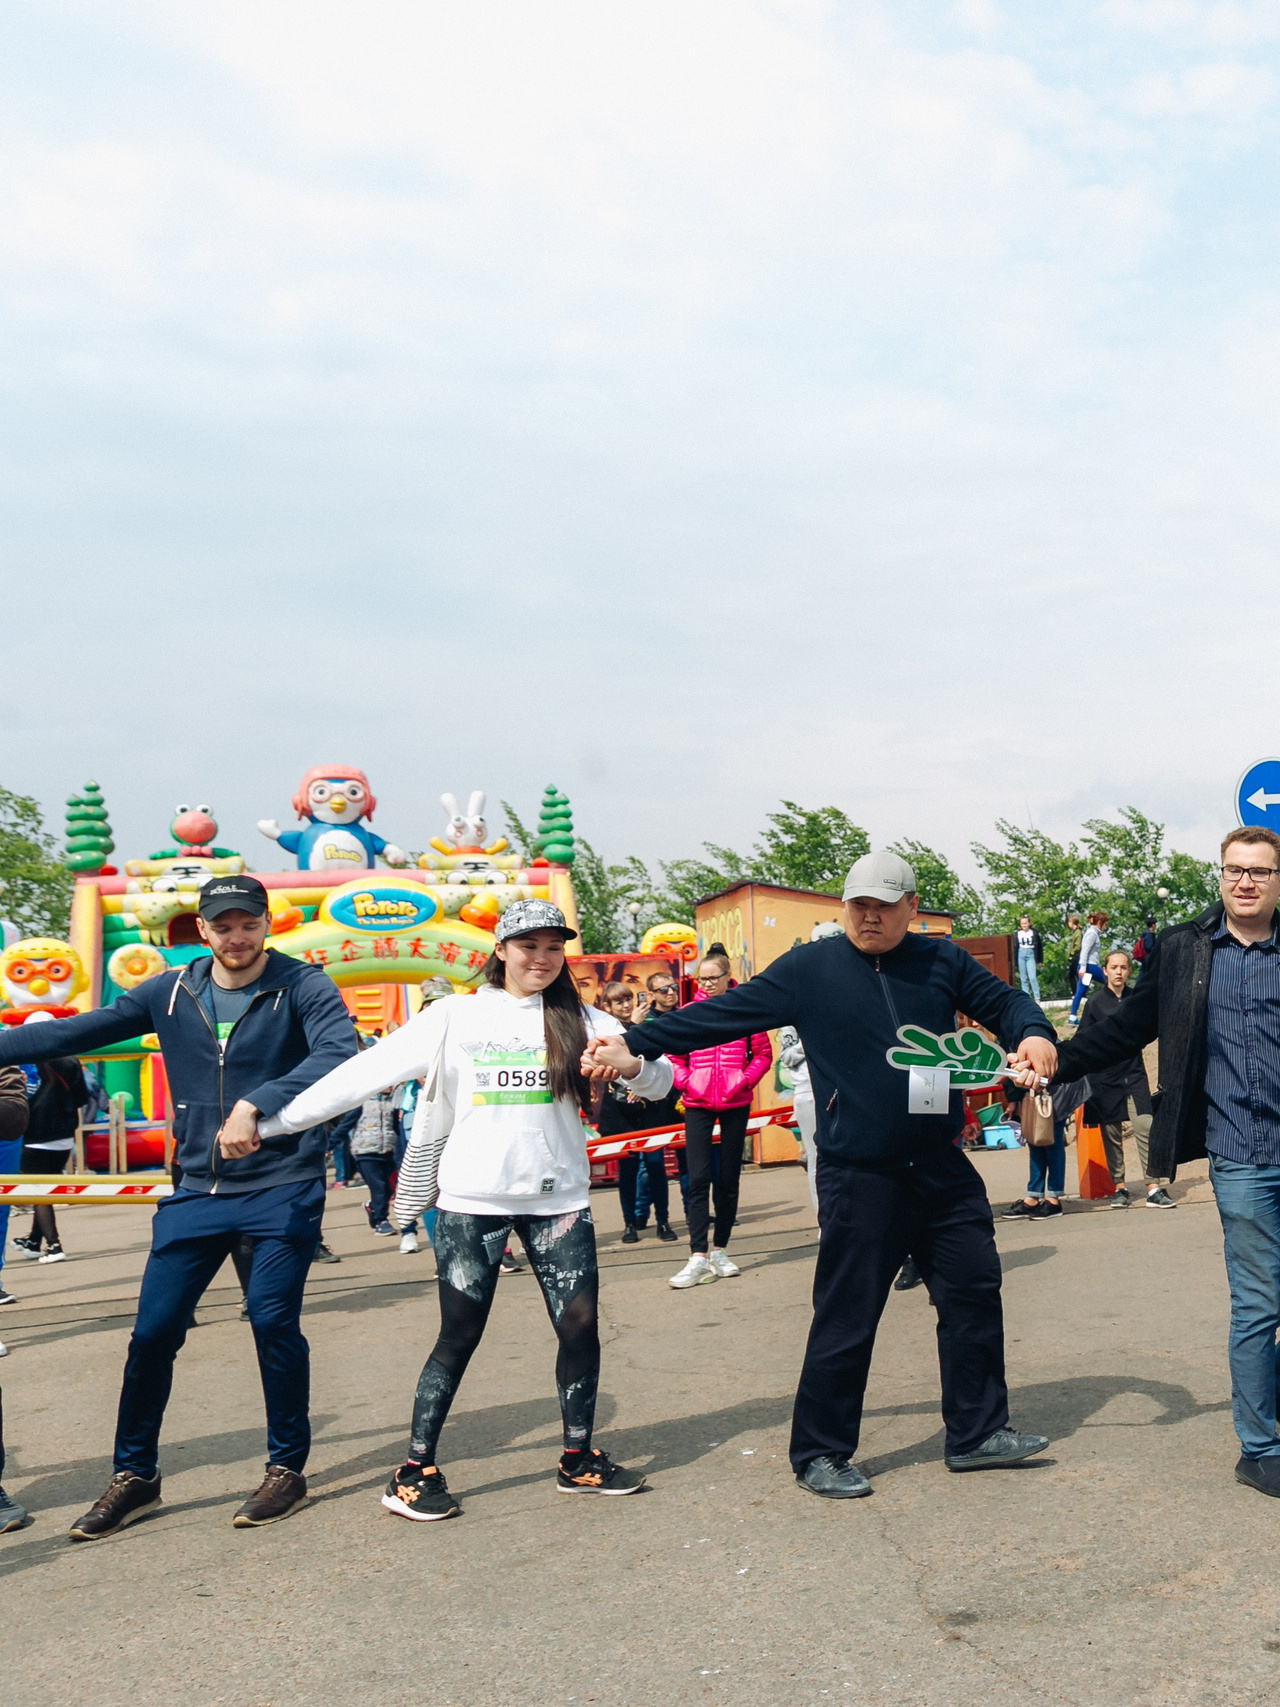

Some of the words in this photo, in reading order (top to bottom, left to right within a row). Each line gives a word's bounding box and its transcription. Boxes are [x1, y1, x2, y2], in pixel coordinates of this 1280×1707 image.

[323, 844, 362, 862] Pororo
[352, 892, 419, 917] Pororo
[497, 1070, 548, 1087] 0589
